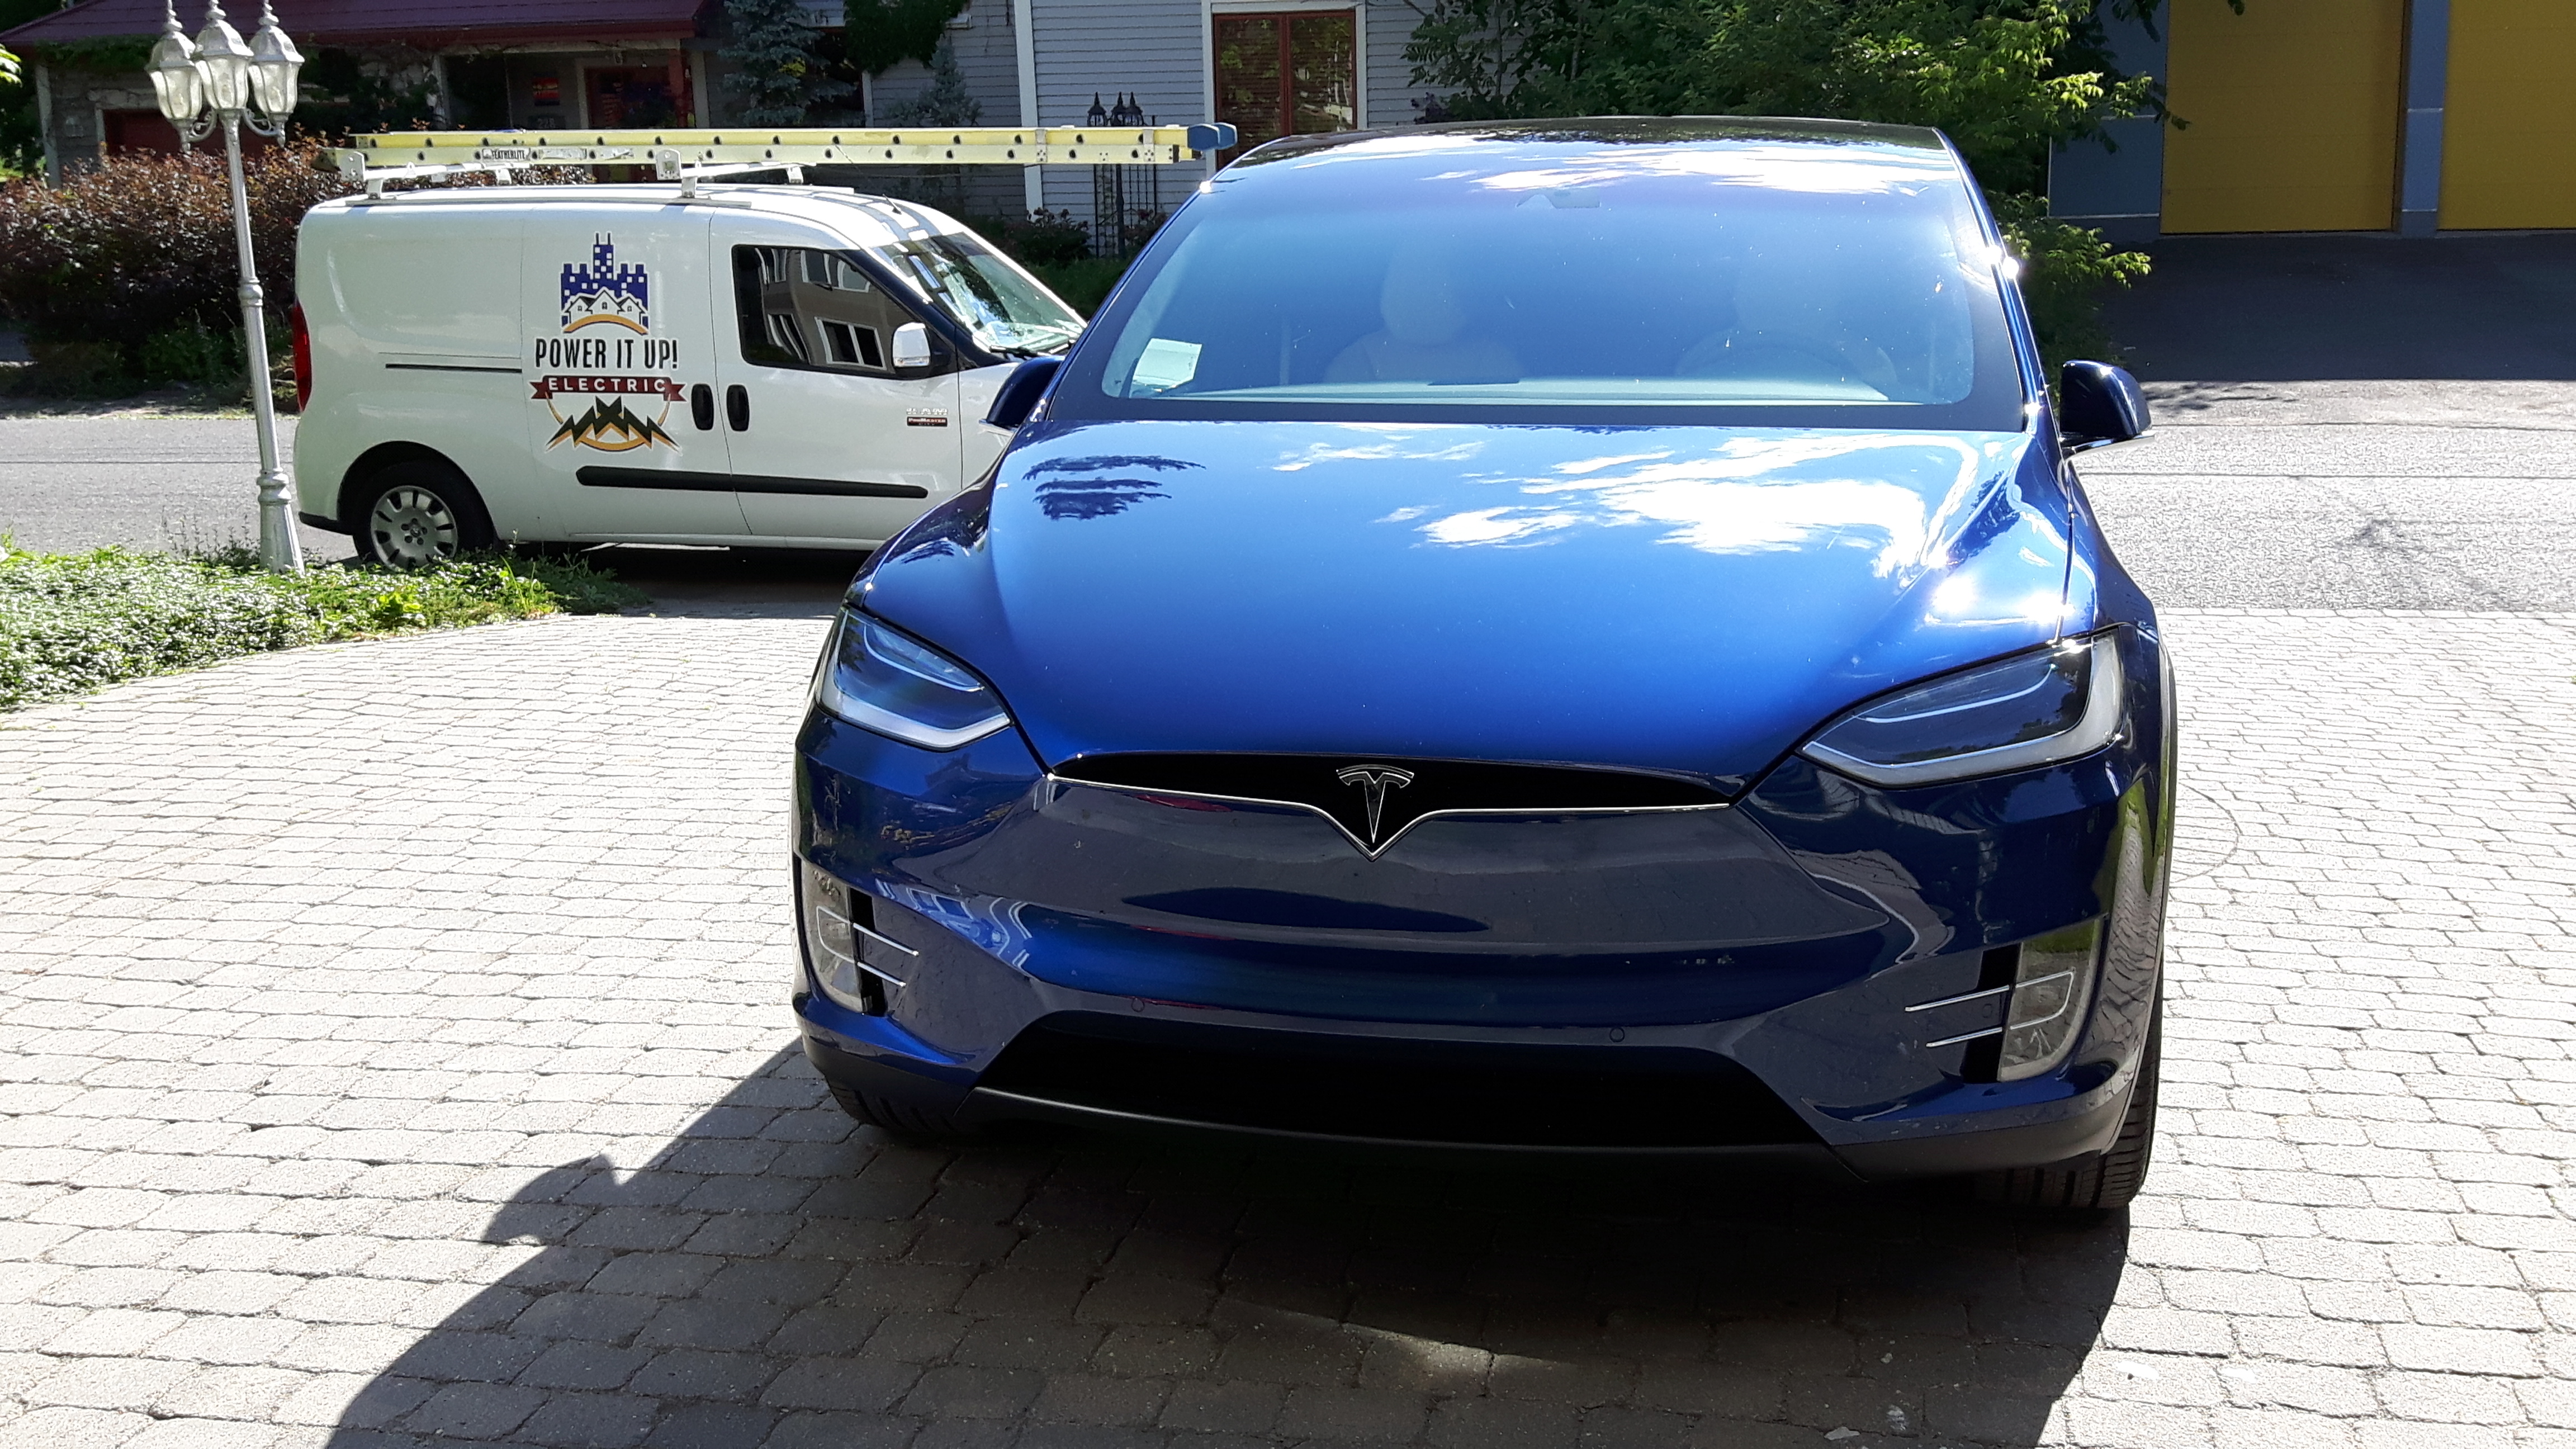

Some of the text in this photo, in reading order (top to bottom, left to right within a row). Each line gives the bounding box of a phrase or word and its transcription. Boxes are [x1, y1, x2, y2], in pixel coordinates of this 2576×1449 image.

[536, 338, 678, 369] POWER IT UP!
[548, 377, 665, 391] ELECTRIC
